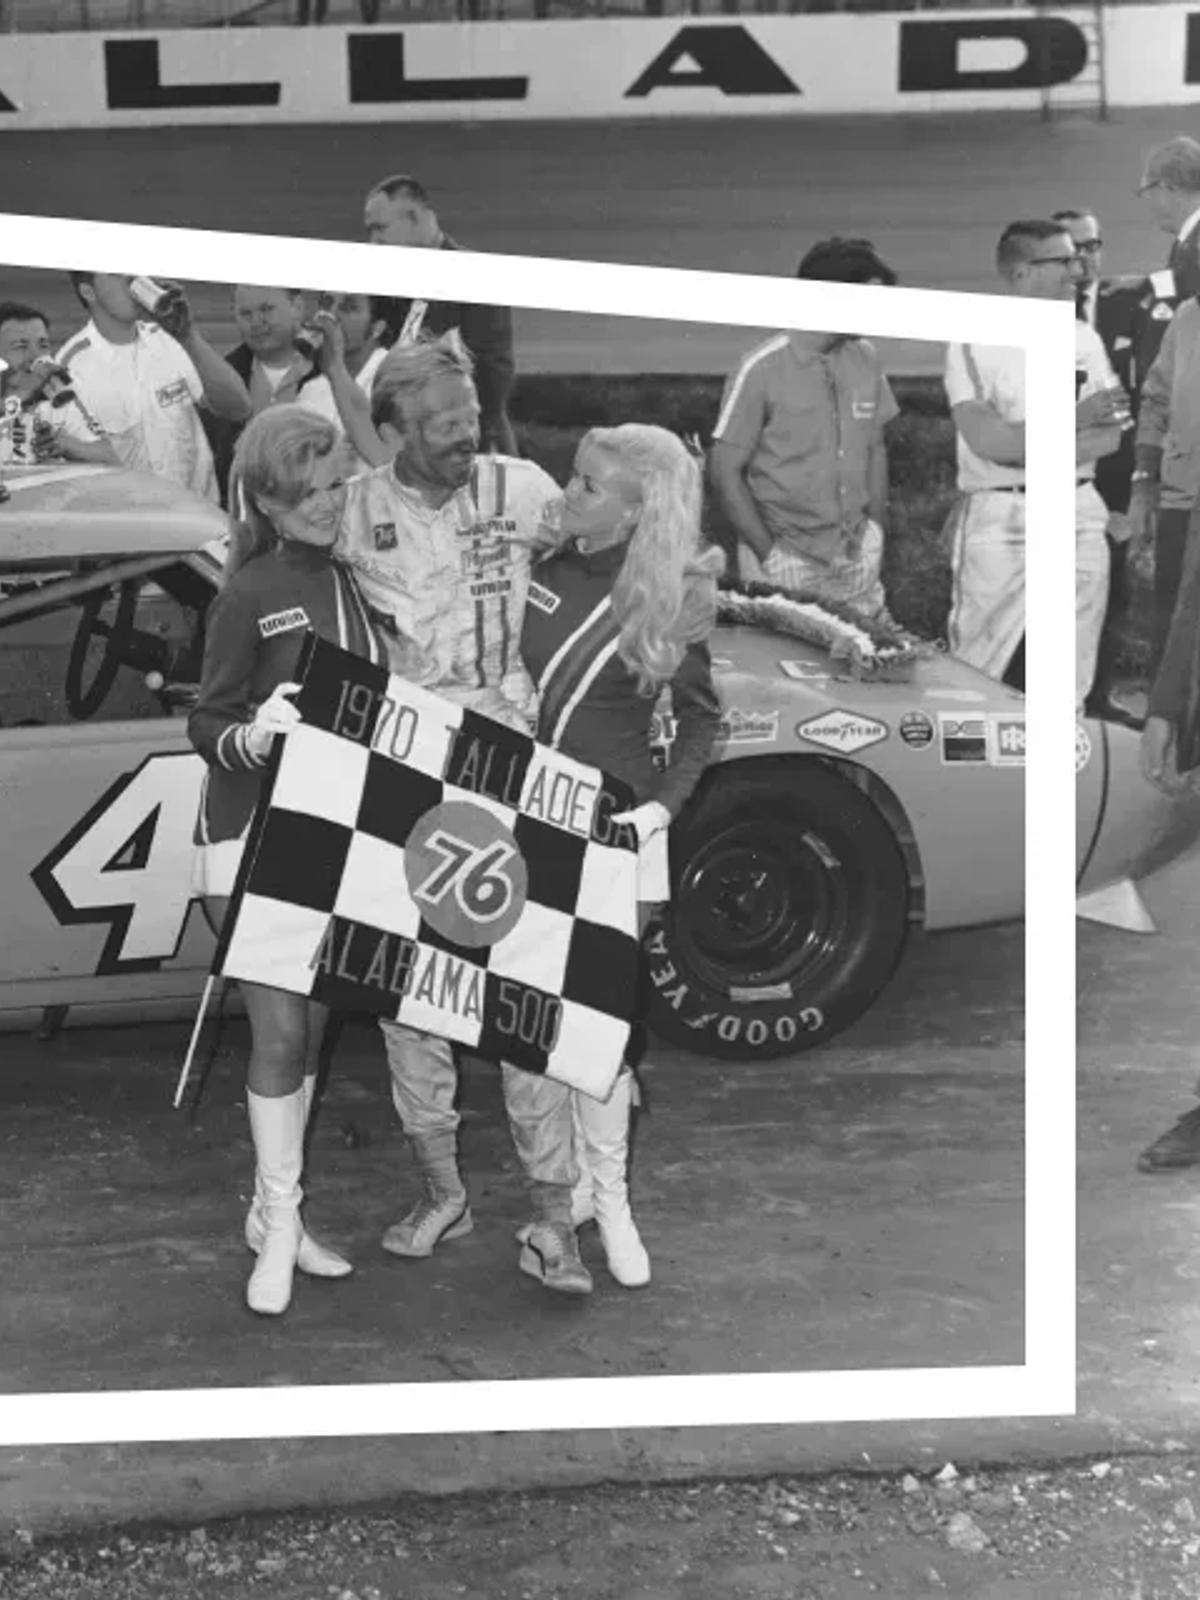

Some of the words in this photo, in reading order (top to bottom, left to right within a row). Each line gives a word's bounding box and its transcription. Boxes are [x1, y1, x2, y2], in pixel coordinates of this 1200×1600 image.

[332, 679, 419, 761] 1970
[444, 724, 636, 850] TALLADEGA
[413, 829, 516, 923] 76
[308, 917, 484, 1023] ALABAMA
[496, 981, 564, 1054] 500
